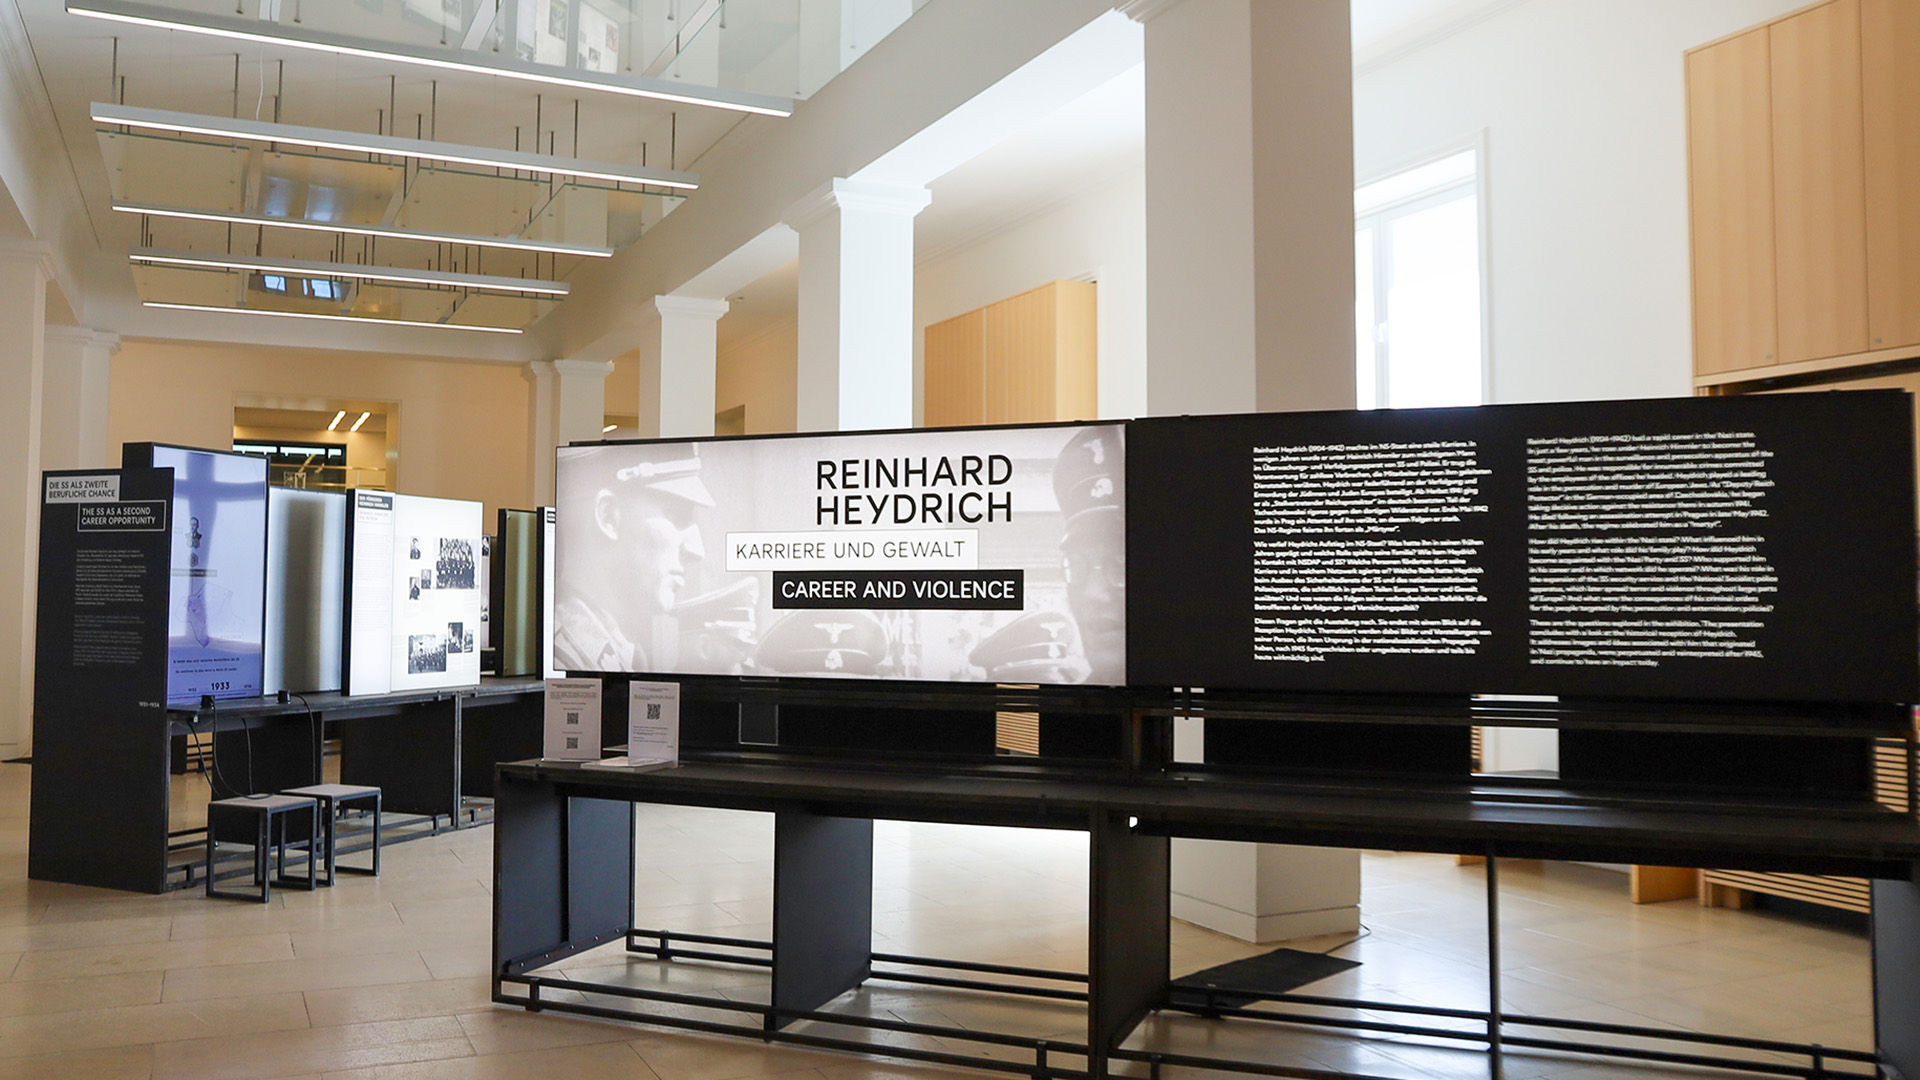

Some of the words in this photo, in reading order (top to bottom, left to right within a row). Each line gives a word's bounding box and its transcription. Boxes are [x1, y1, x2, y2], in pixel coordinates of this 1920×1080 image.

[817, 455, 1013, 490] REINHARD
[49, 481, 60, 490] DIE
[61, 481, 69, 489] SS
[70, 481, 83, 489] ALS
[84, 480, 108, 489] ZWEITE
[49, 490, 87, 498] BERUFLICHE
[89, 489, 115, 497] CHANCE
[82, 508, 95, 516] THE
[96, 507, 105, 516] SS
[106, 507, 115, 515] AS
[117, 507, 122, 515] A
[123, 507, 150, 515] SECOND
[817, 492, 1012, 525] HEYDRICH
[81, 517, 107, 525] CAREER
[109, 516, 156, 524] OPPORTUNITY
[736, 543, 826, 560] KARRIERE
[834, 542, 875, 558] UND
[883, 541, 965, 558] GEWALT
[781, 580, 857, 599] CAREER
[863, 580, 906, 599] AND
[913, 580, 1015, 599] VIOLENCE
[211, 682, 230, 691] 1933
